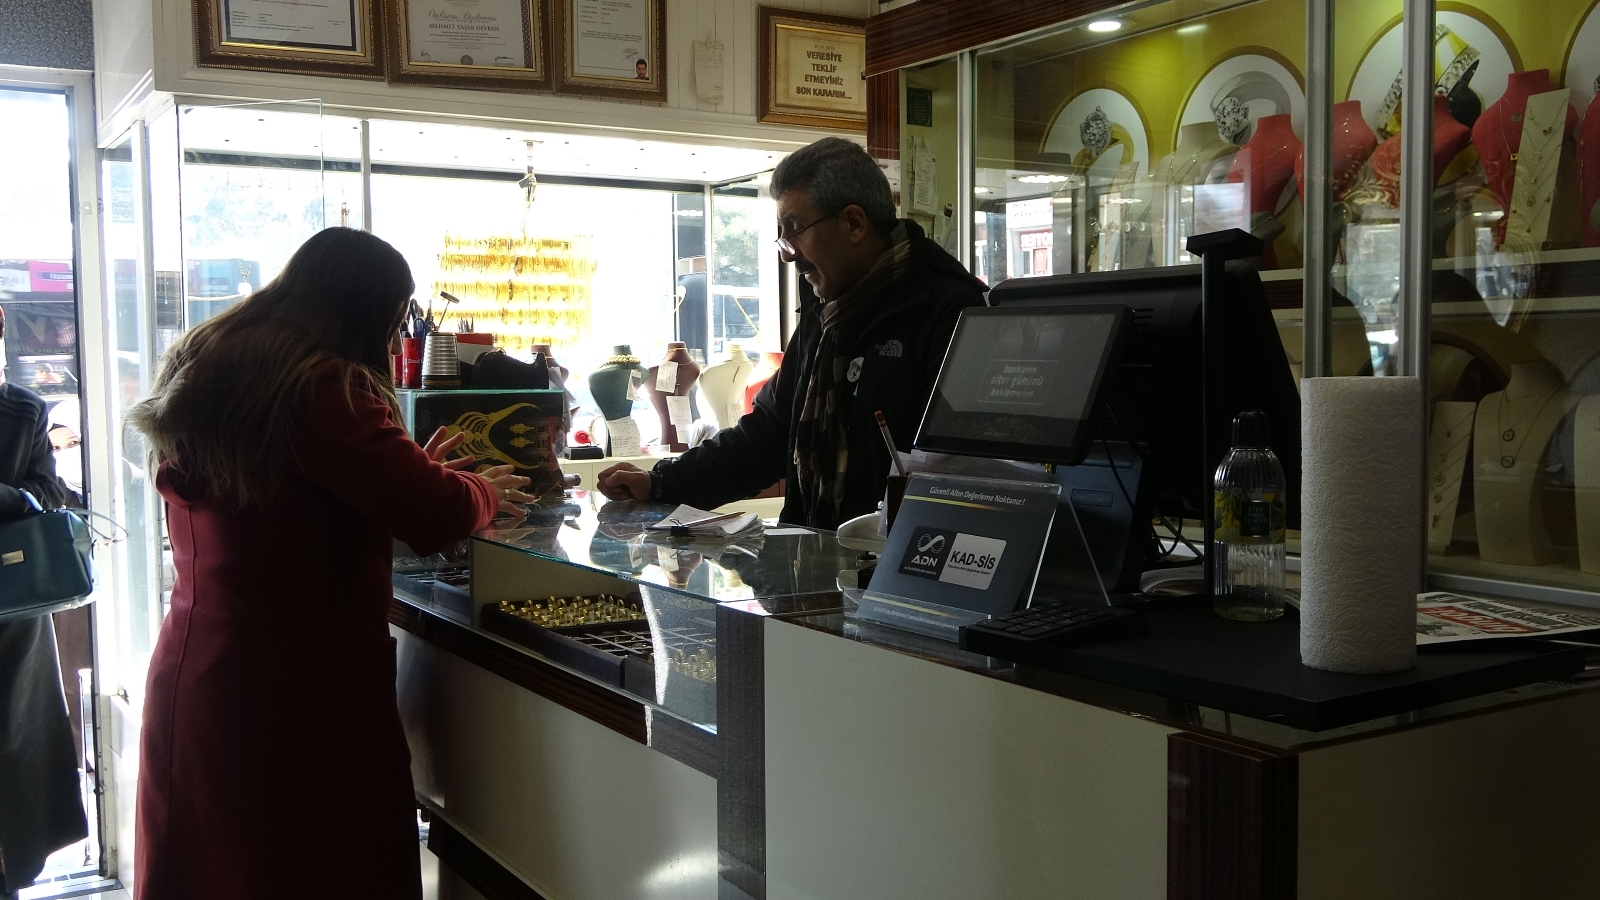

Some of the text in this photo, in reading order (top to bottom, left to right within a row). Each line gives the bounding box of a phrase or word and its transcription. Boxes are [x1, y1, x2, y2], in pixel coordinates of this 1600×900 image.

[806, 51, 842, 62] VERESİYE
[812, 63, 837, 73] TEKLİF
[804, 74, 844, 86] ETMEYİNİZ
[795, 86, 811, 95] SON
[1003, 364, 1038, 374] bankanın
[990, 374, 1045, 387] altın gününü
[929, 486, 950, 495] Güvenli
[949, 488, 964, 497] Altın
[963, 490, 995, 502] Değerleme
[993, 494, 1021, 505] Noktanız
[911, 555, 938, 567] ADN
[949, 550, 996, 569] KAD-SİS
